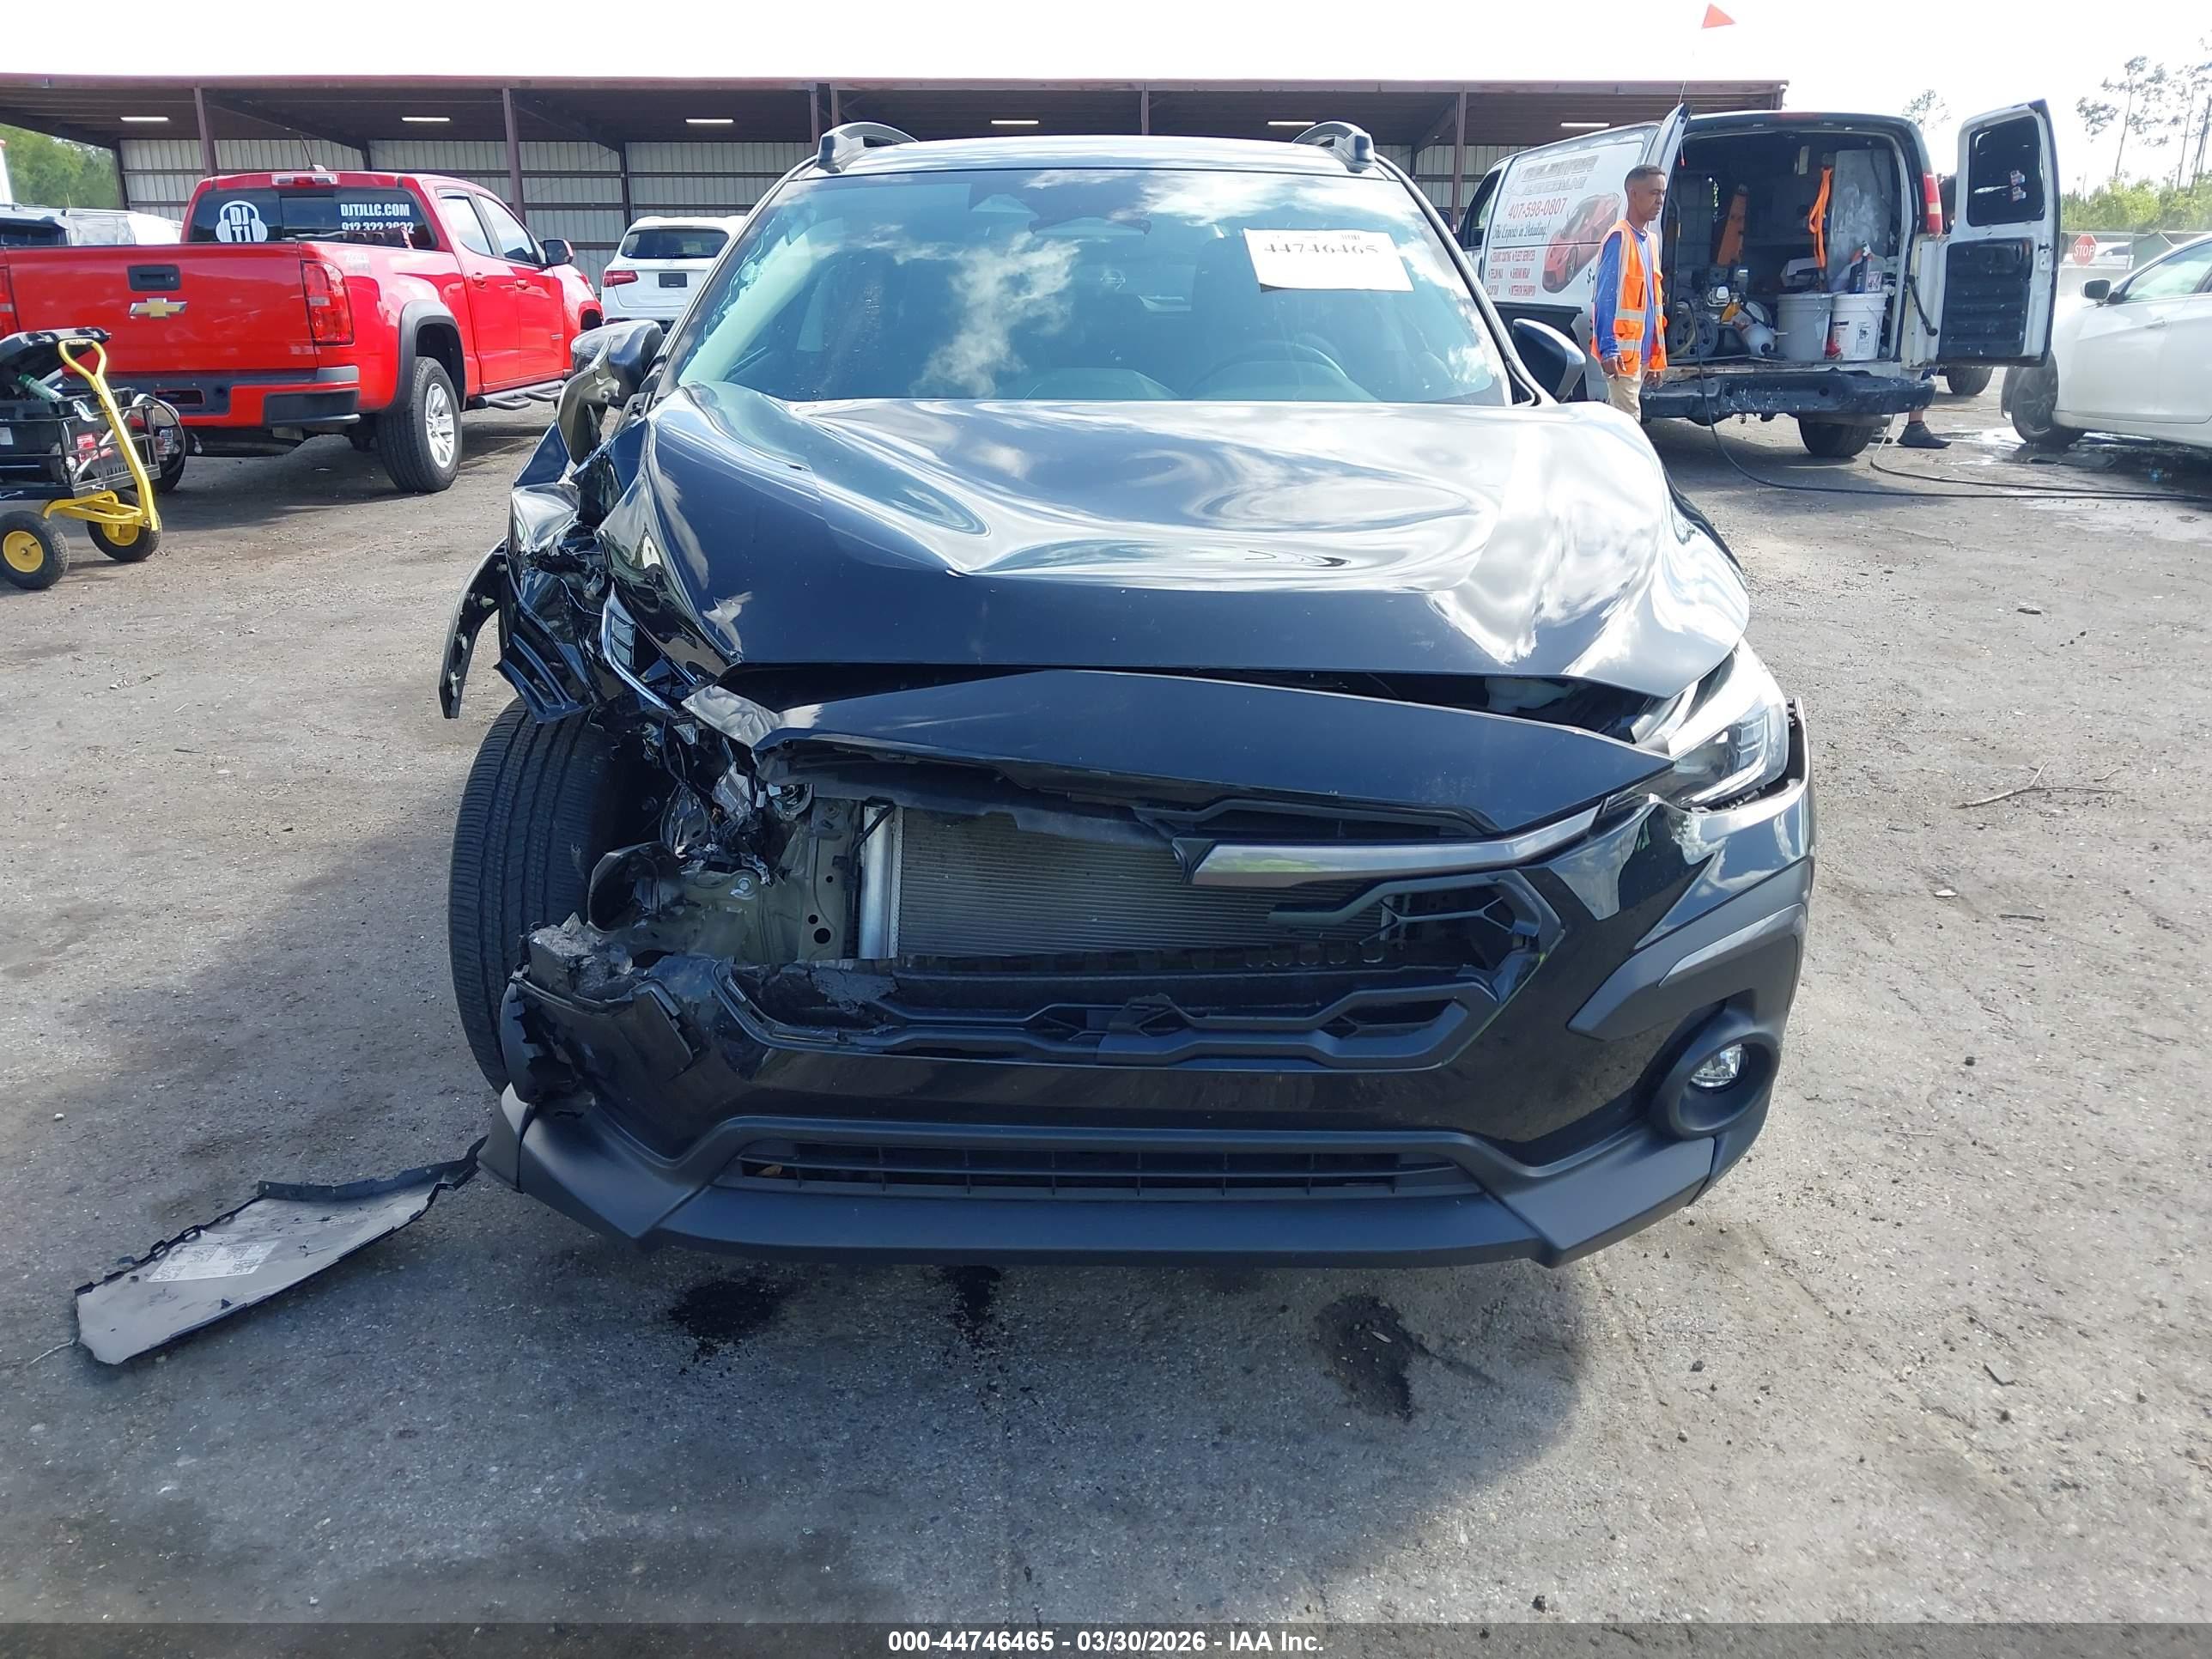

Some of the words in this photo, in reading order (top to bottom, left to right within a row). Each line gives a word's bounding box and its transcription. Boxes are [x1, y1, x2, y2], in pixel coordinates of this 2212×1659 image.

[229, 206, 249, 225] DJ
[340, 204, 410, 216] DJTJLLC.COM
[1508, 198, 1568, 220] 407-598-0807
[2074, 245, 2095, 257] STOP
